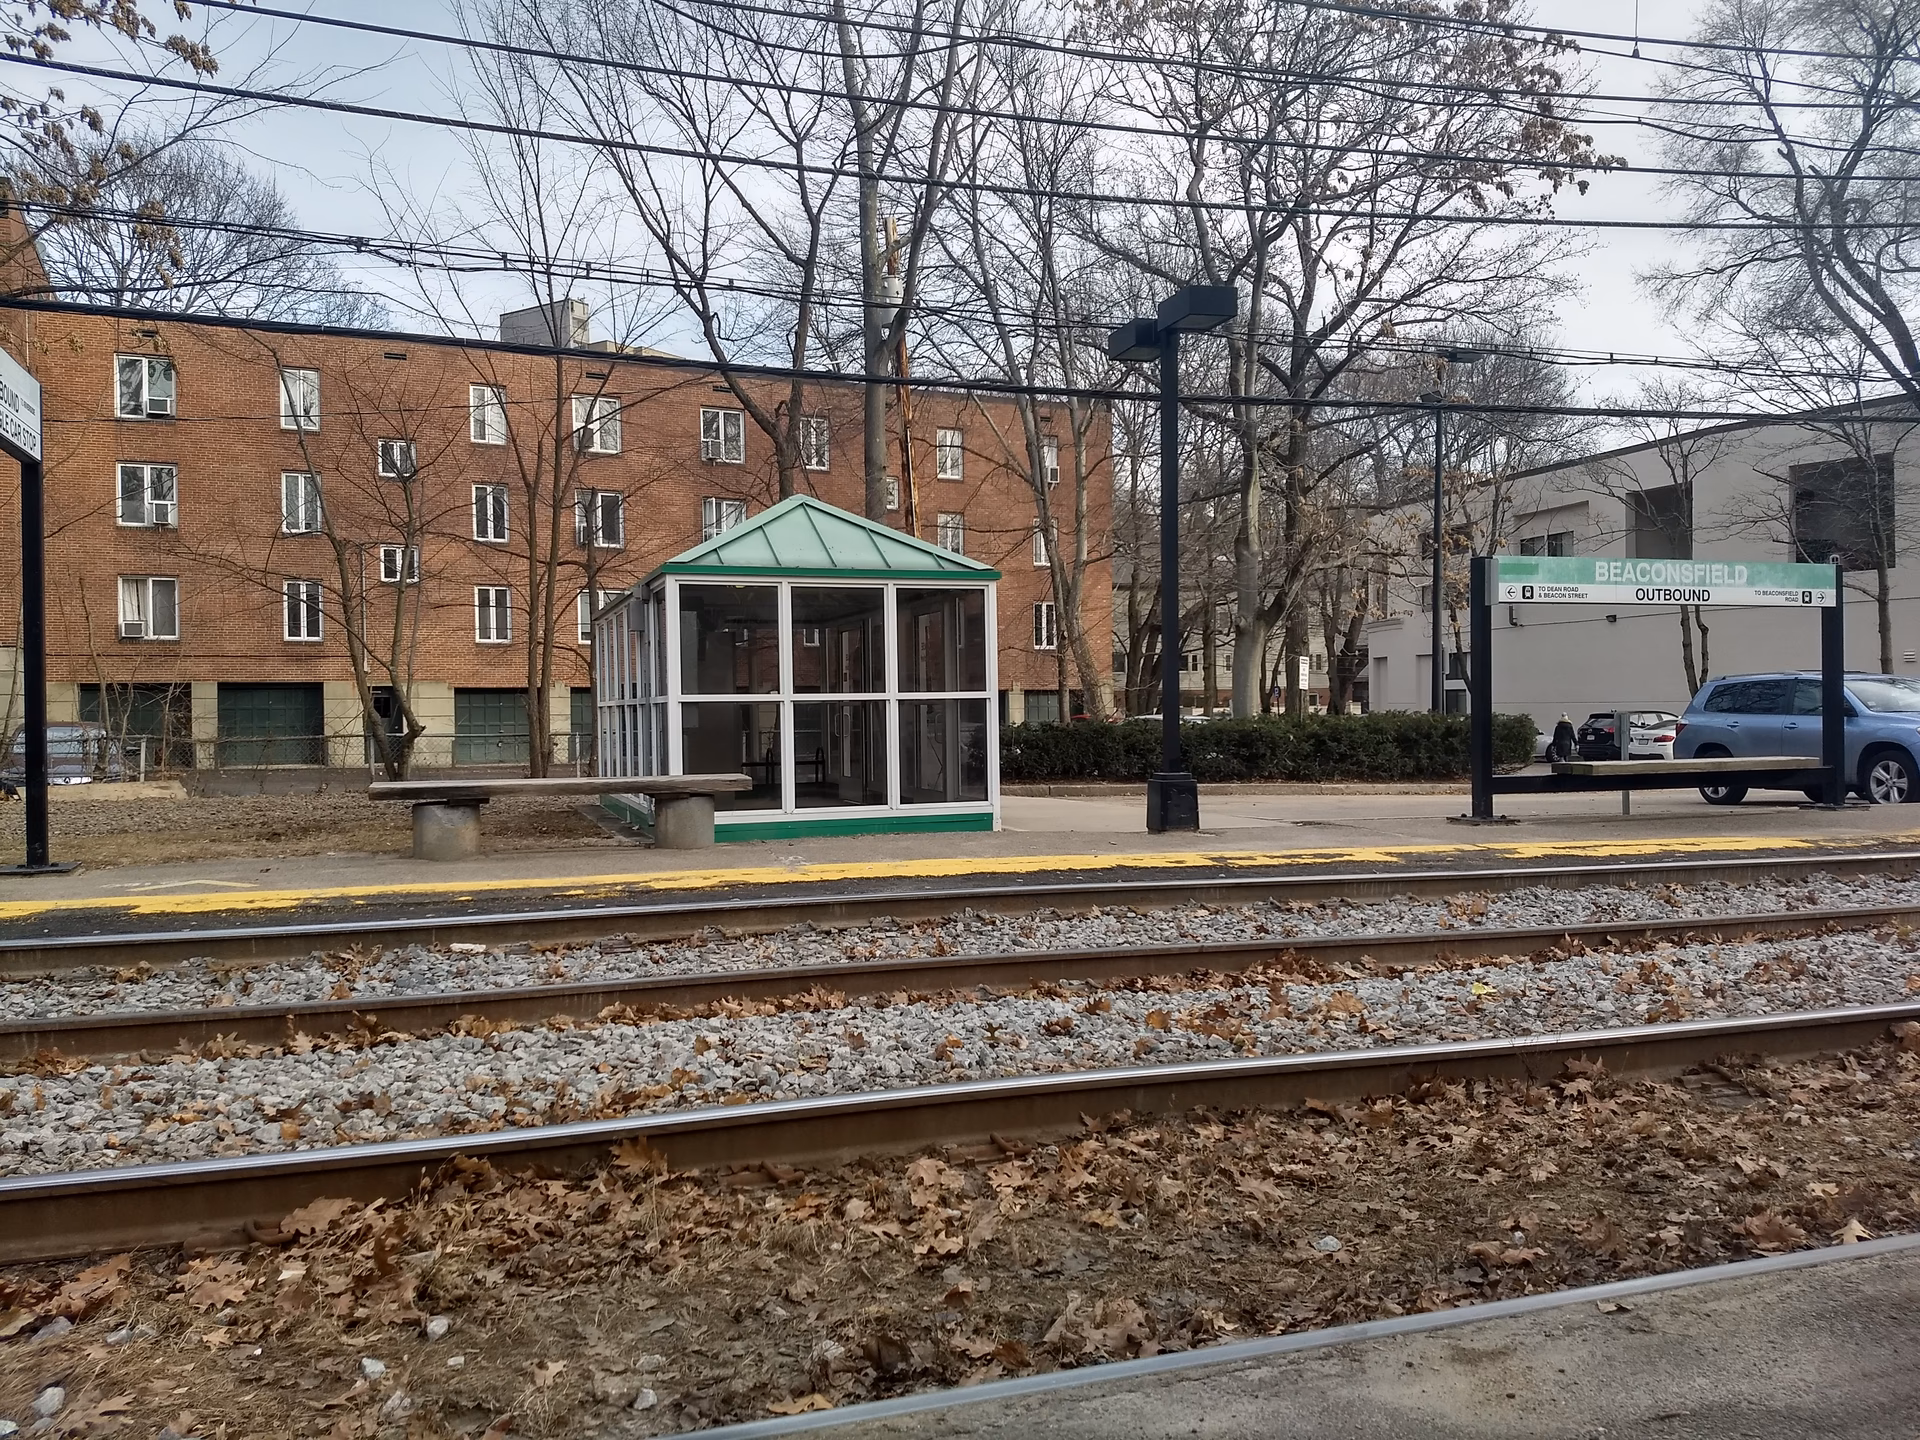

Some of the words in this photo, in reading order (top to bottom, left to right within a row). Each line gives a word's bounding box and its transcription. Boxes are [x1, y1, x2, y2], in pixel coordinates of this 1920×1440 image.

[10, 418, 22, 444] CAR
[23, 427, 37, 453] STOP
[1595, 561, 1748, 584] BEACONSFIELD
[1635, 588, 1711, 602] OUTBOUND
